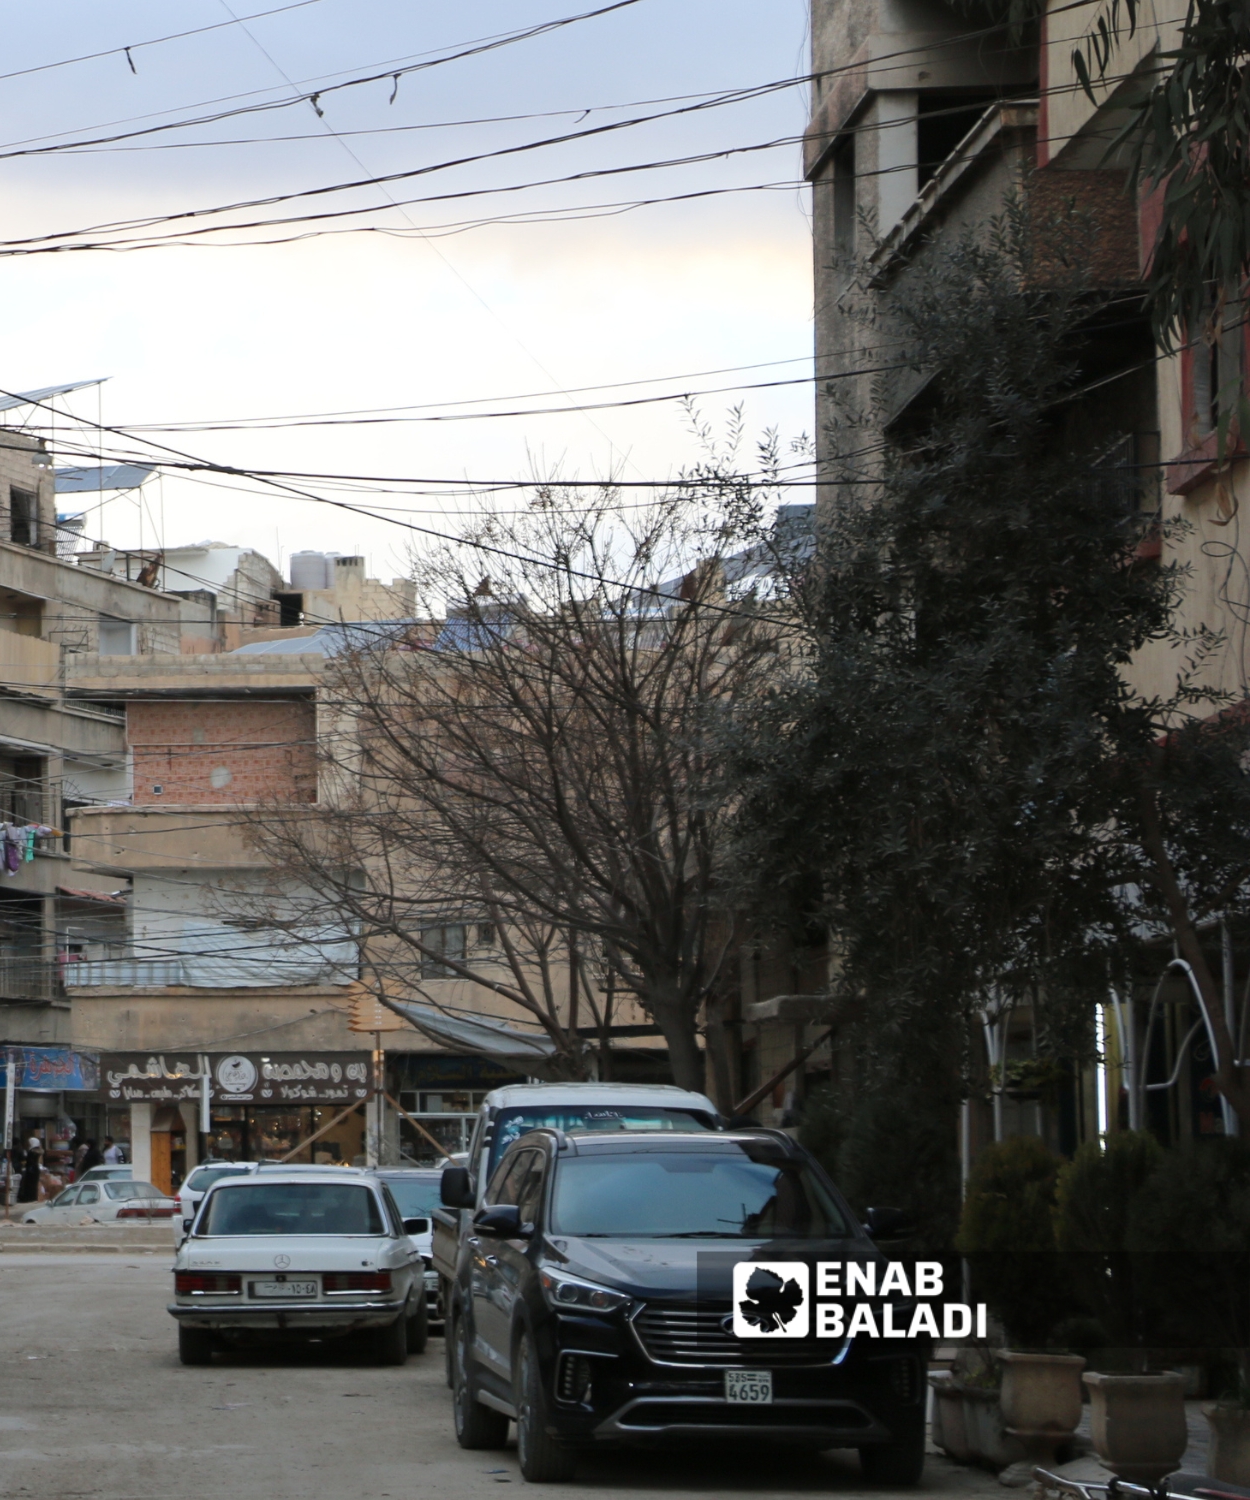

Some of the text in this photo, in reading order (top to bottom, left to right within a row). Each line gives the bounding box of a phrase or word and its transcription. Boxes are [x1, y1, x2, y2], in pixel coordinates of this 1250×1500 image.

[107, 1054, 212, 1088] الهاشمي
[262, 1058, 330, 1082] محمصة
[729, 1384, 770, 1401] 4659
